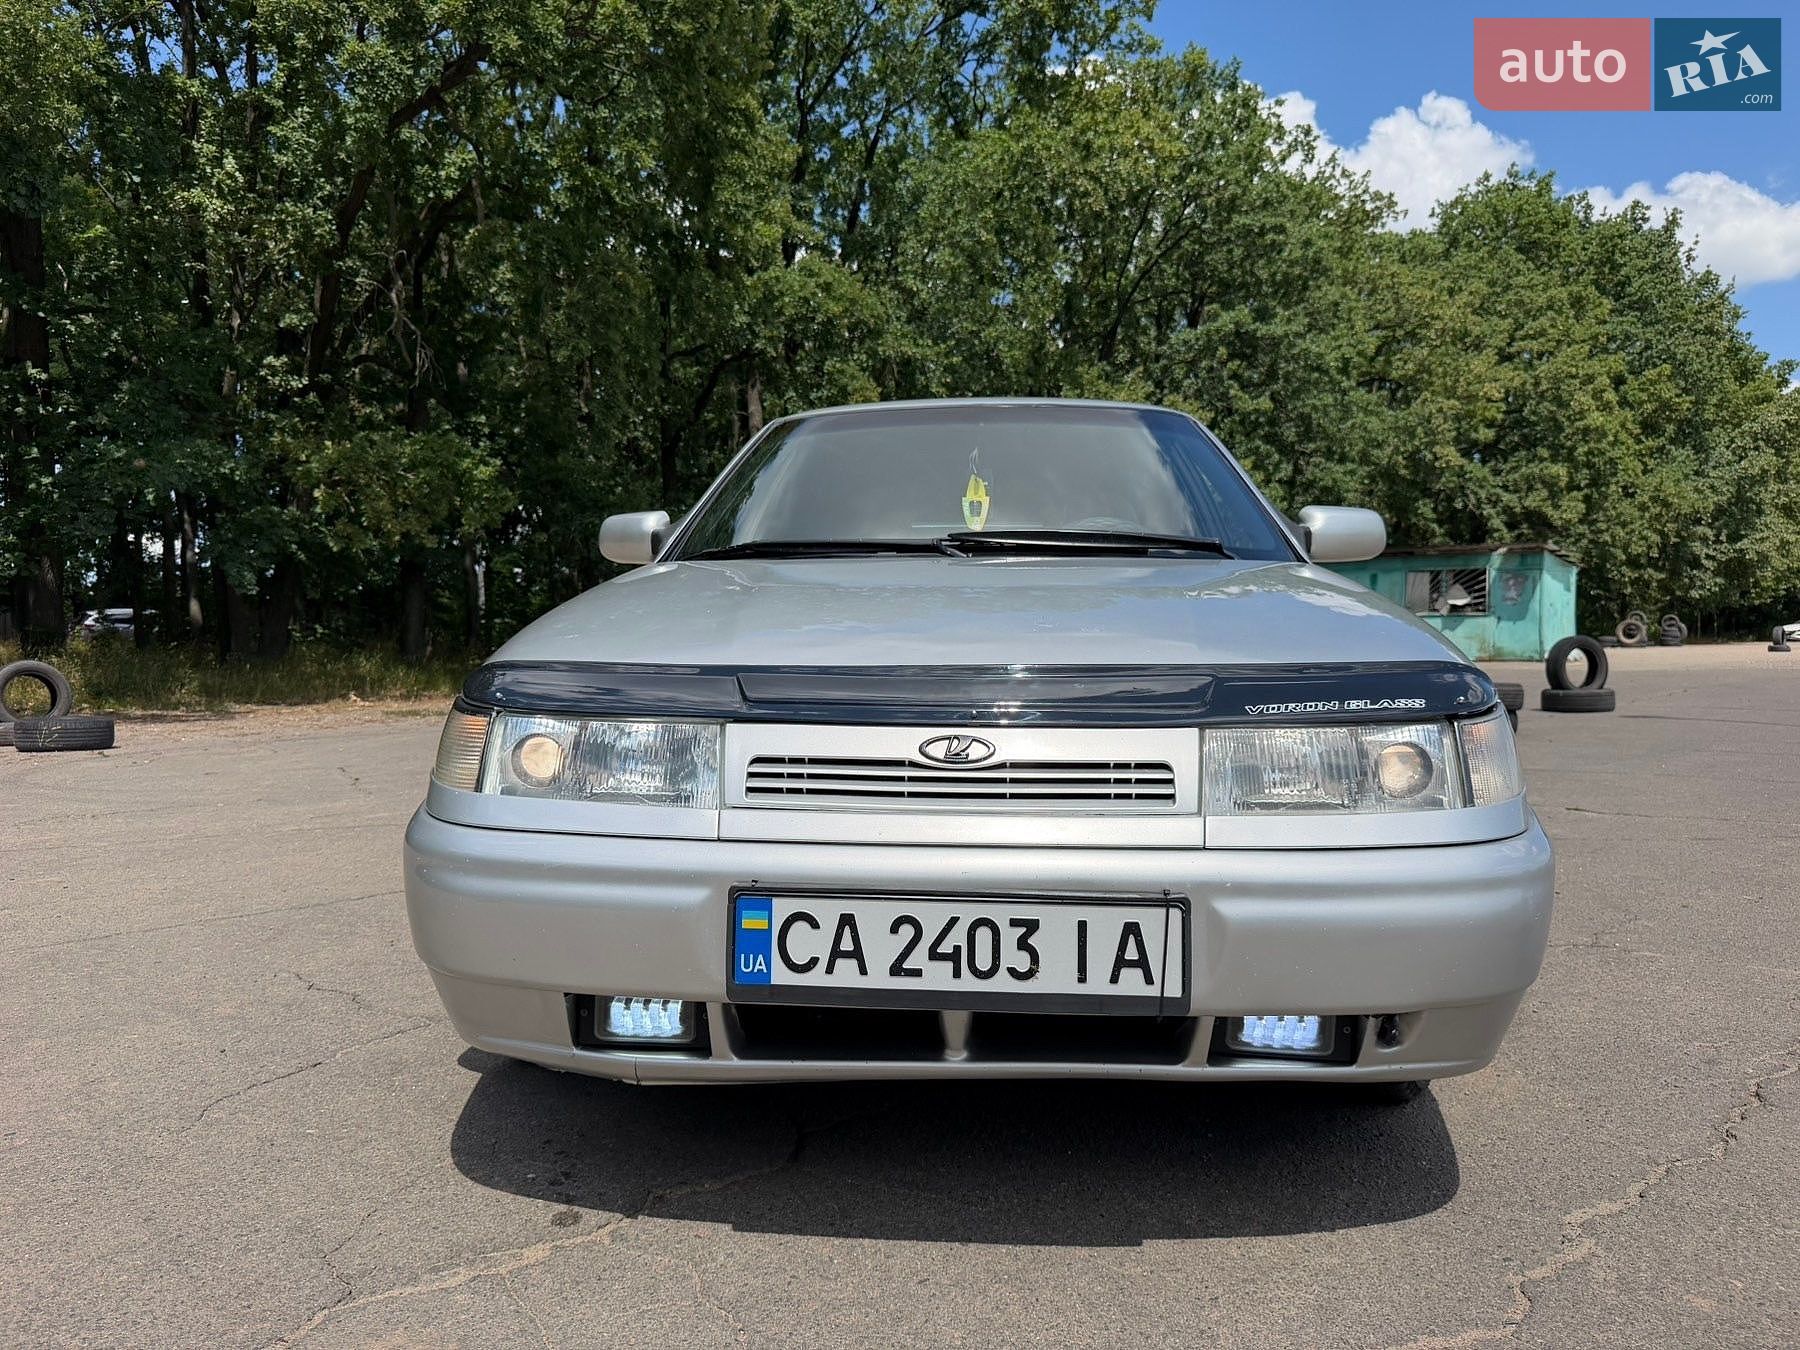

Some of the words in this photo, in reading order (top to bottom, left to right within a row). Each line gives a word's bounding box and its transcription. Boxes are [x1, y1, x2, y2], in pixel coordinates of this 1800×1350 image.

[1245, 700, 1339, 715] VORON
[1344, 698, 1426, 710] GLASS
[776, 910, 869, 977] CA
[889, 914, 1041, 981] 2403
[1076, 918, 1156, 986] IA
[740, 953, 768, 974] UA
